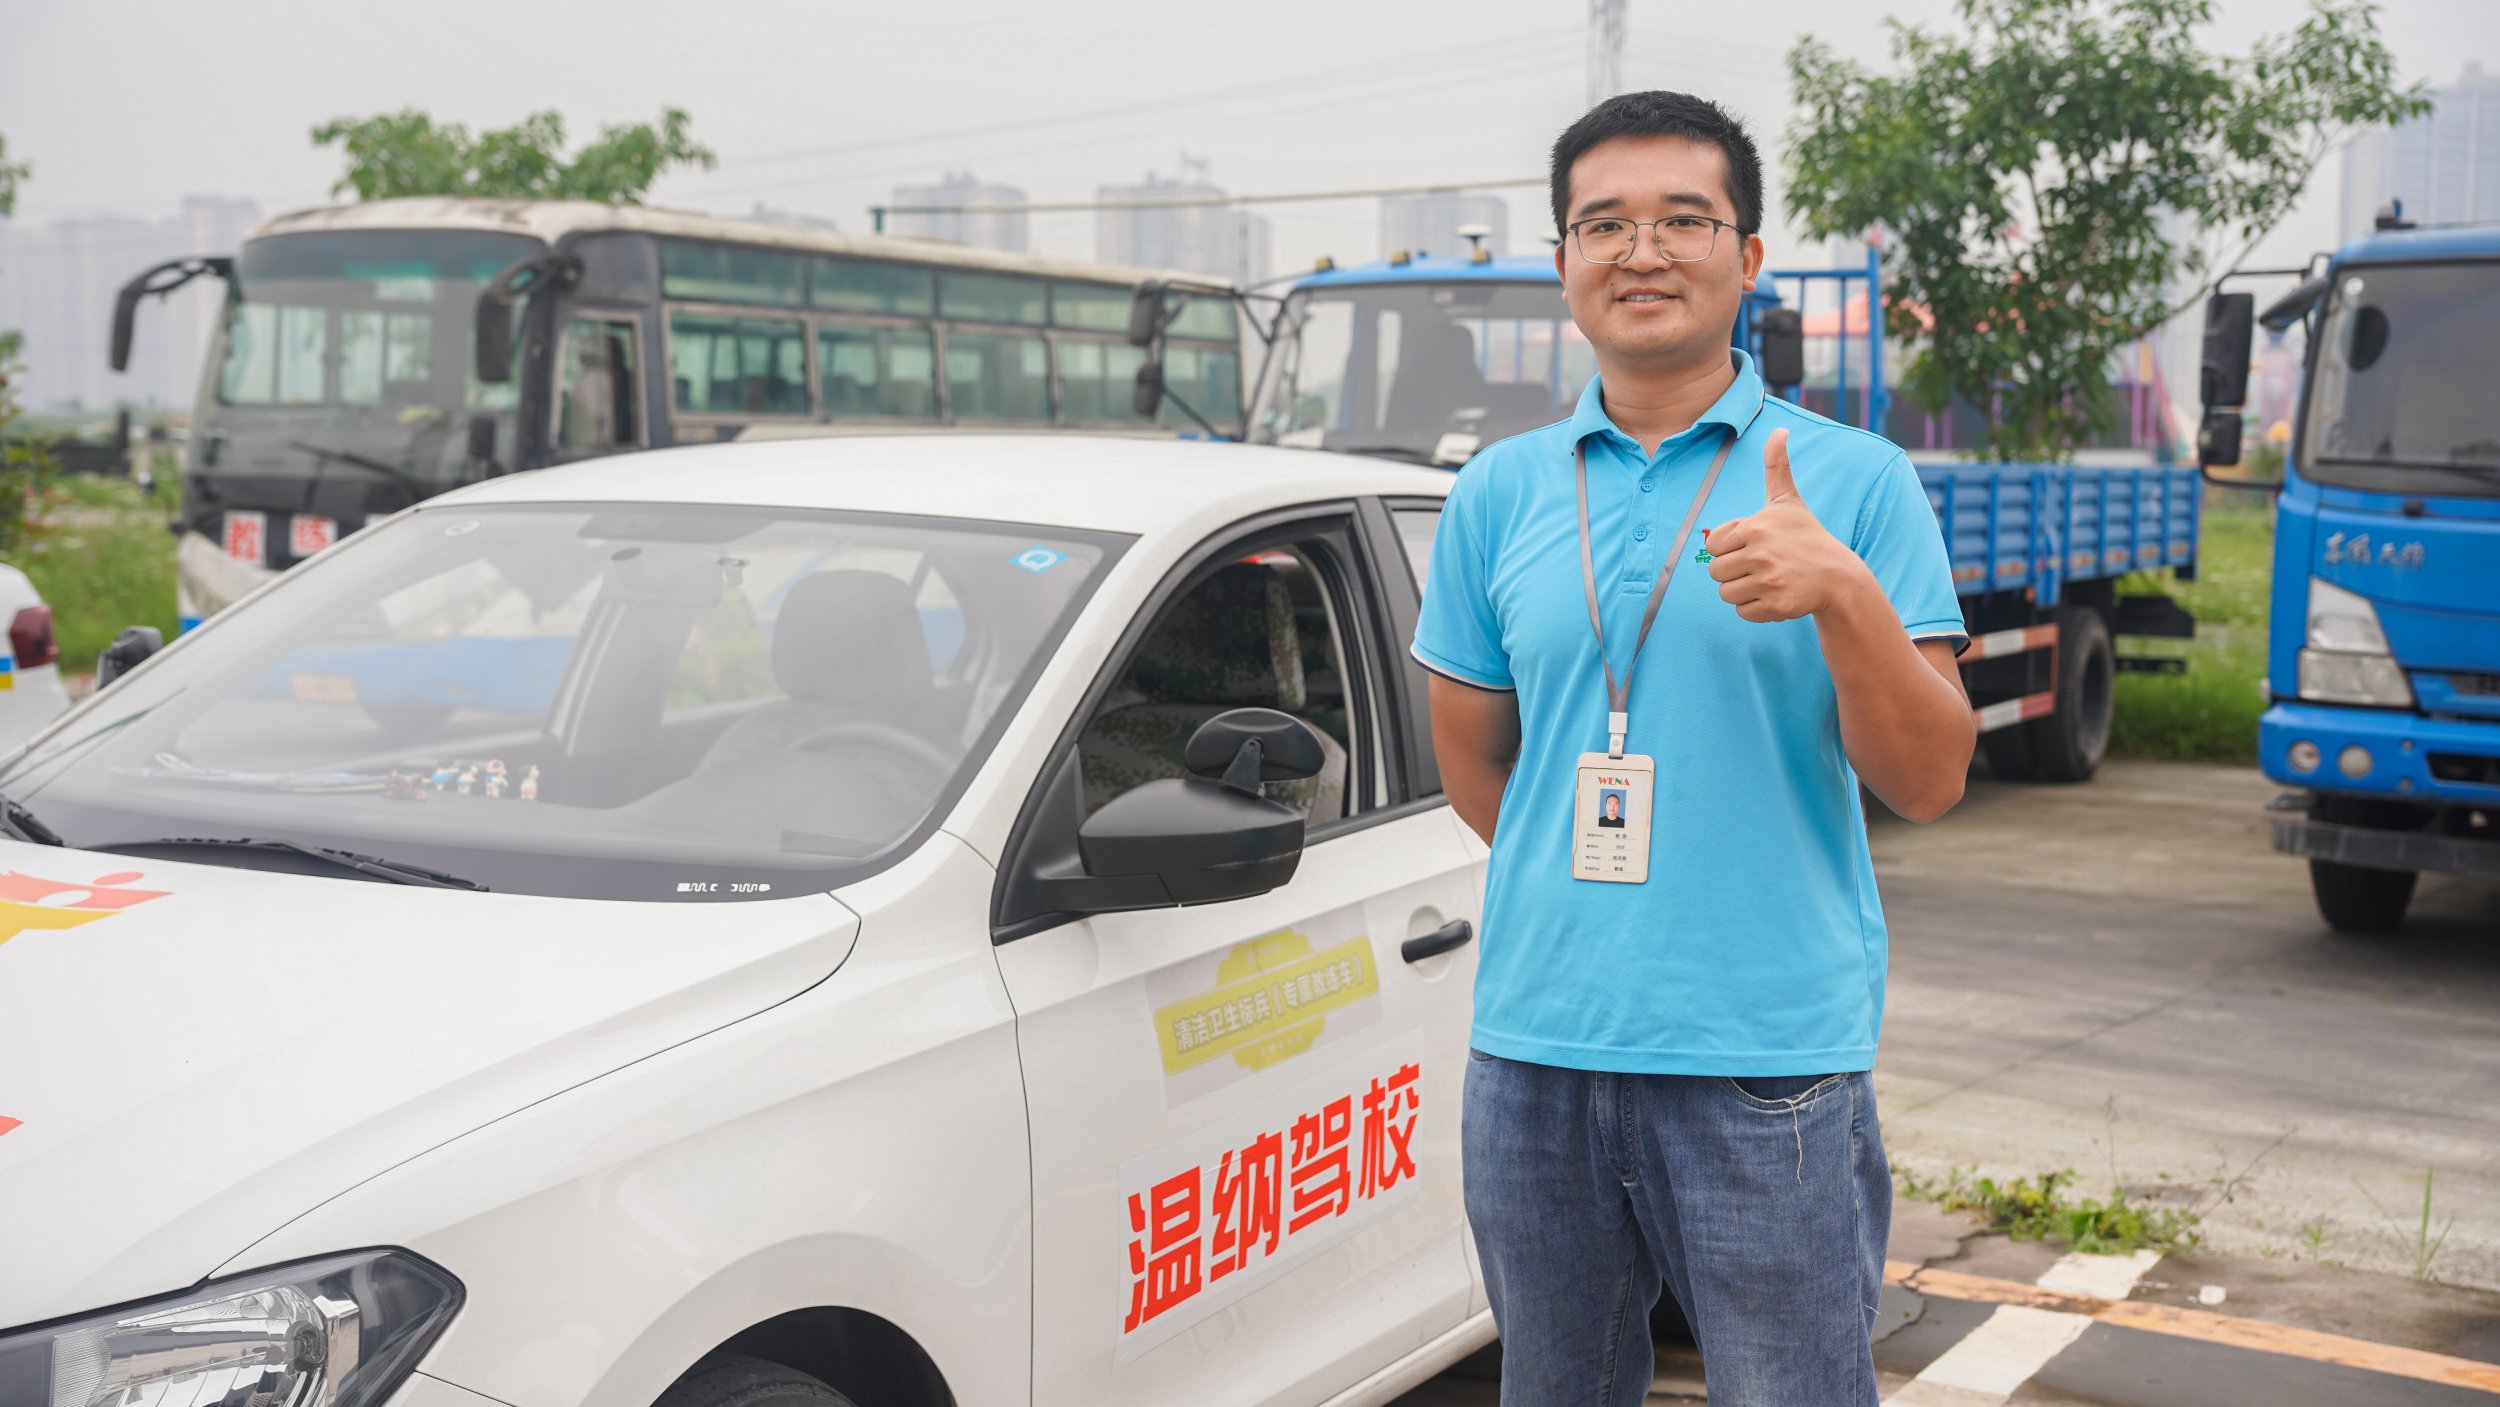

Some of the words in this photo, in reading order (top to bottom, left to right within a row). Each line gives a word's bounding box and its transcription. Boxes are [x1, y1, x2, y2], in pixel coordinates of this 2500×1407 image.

[1597, 776, 1630, 786] WENA
[1124, 1063, 1420, 1334] 温纳驾校
